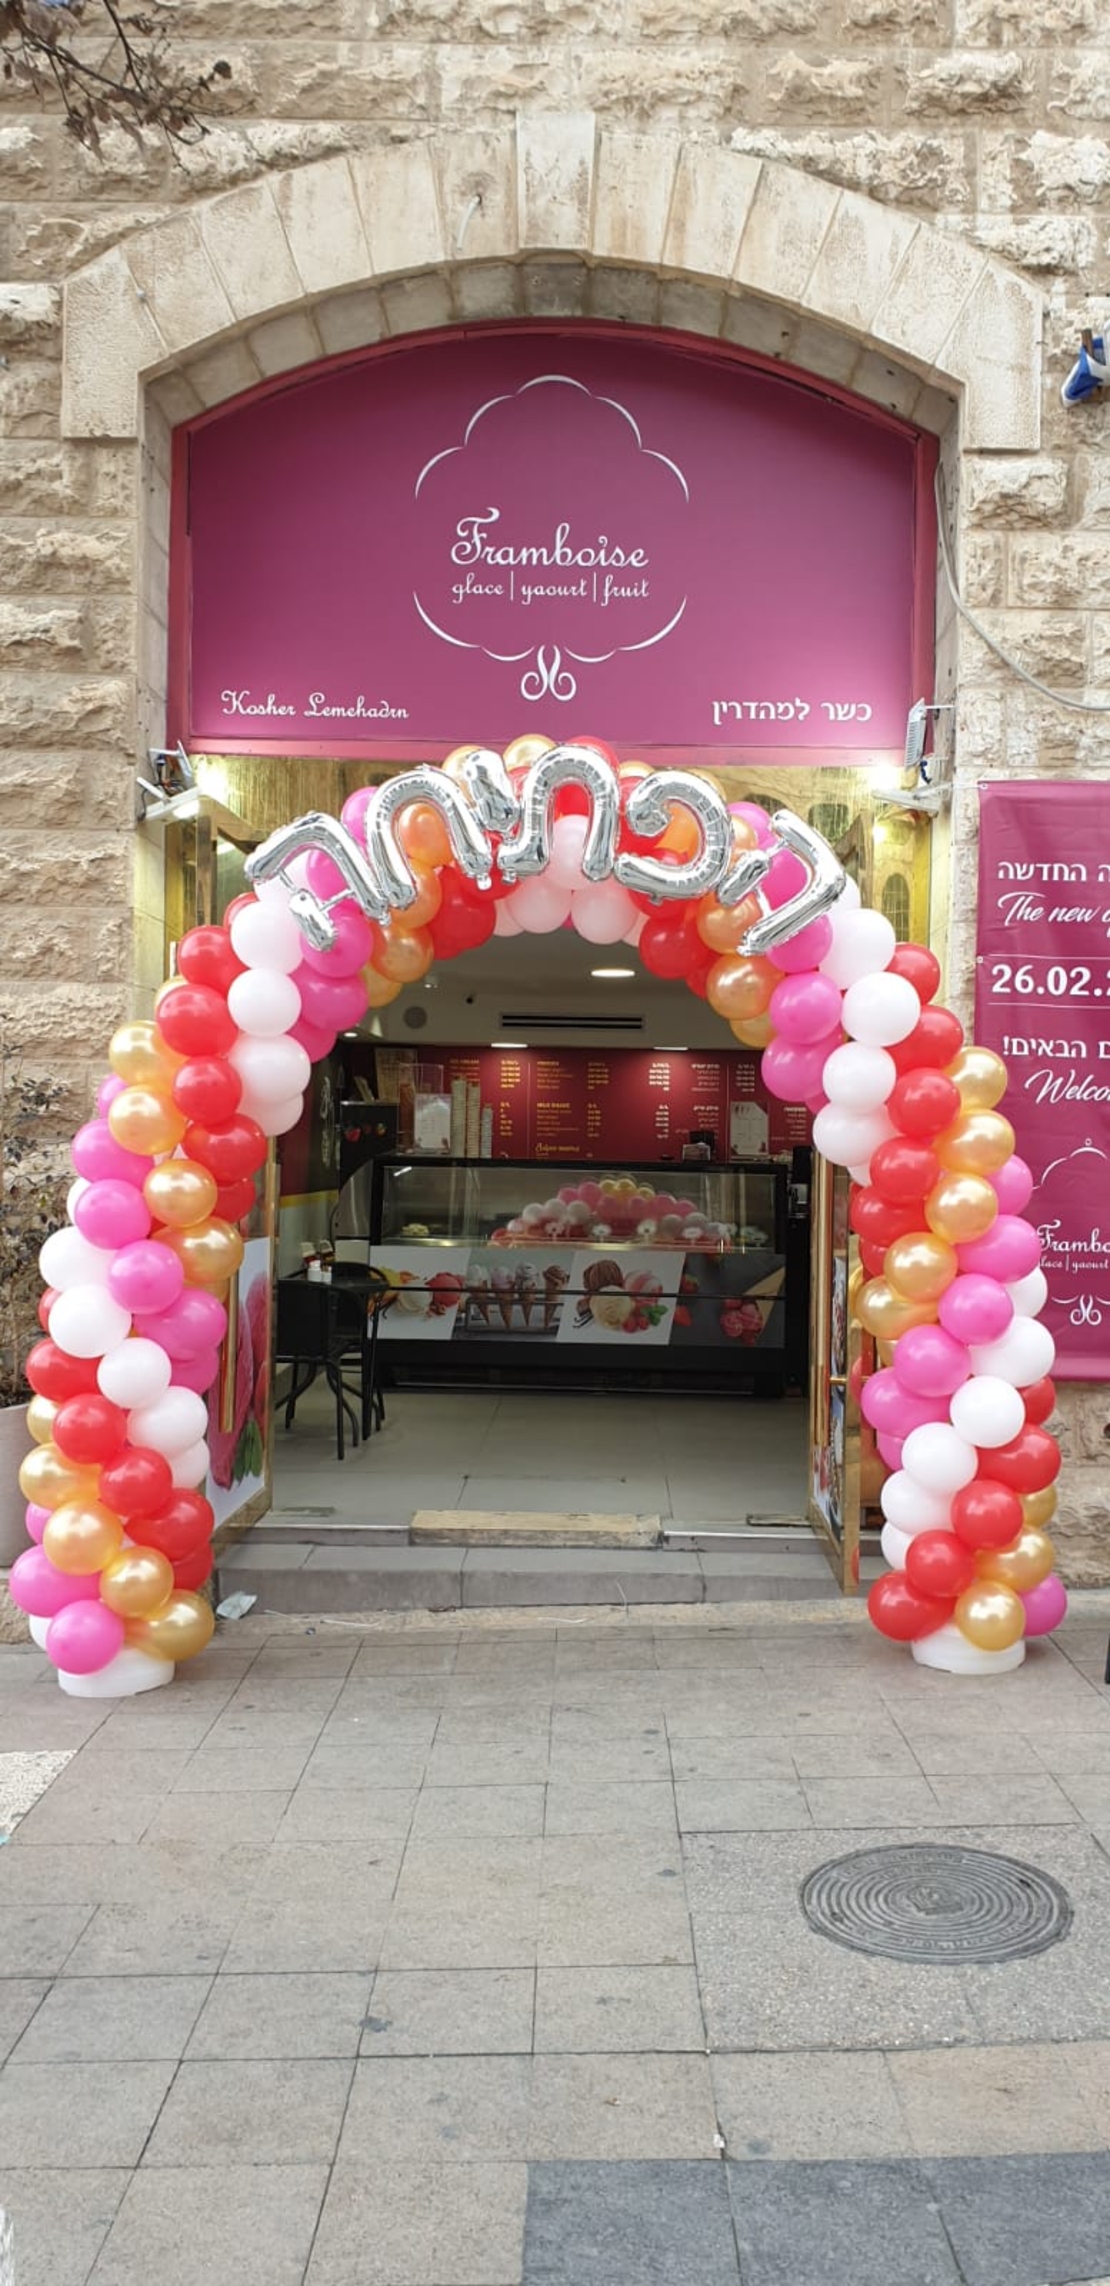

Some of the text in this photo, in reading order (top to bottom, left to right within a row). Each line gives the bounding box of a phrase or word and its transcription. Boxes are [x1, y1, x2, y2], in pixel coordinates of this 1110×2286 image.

[451, 507, 649, 568] Framboise
[452, 572, 649, 606] glace yaourt fruit
[221, 690, 296, 716] Kosher
[712, 697, 873, 725] כשר למהדרין
[998, 861, 1087, 881] החדשה
[997, 891, 1101, 927] The new
[991, 964, 1110, 996] 26.02.
[1003, 1036, 1087, 1059] הבאים!
[1024, 1069, 1110, 1104] Welco
[1038, 1255, 1063, 1269] lace
